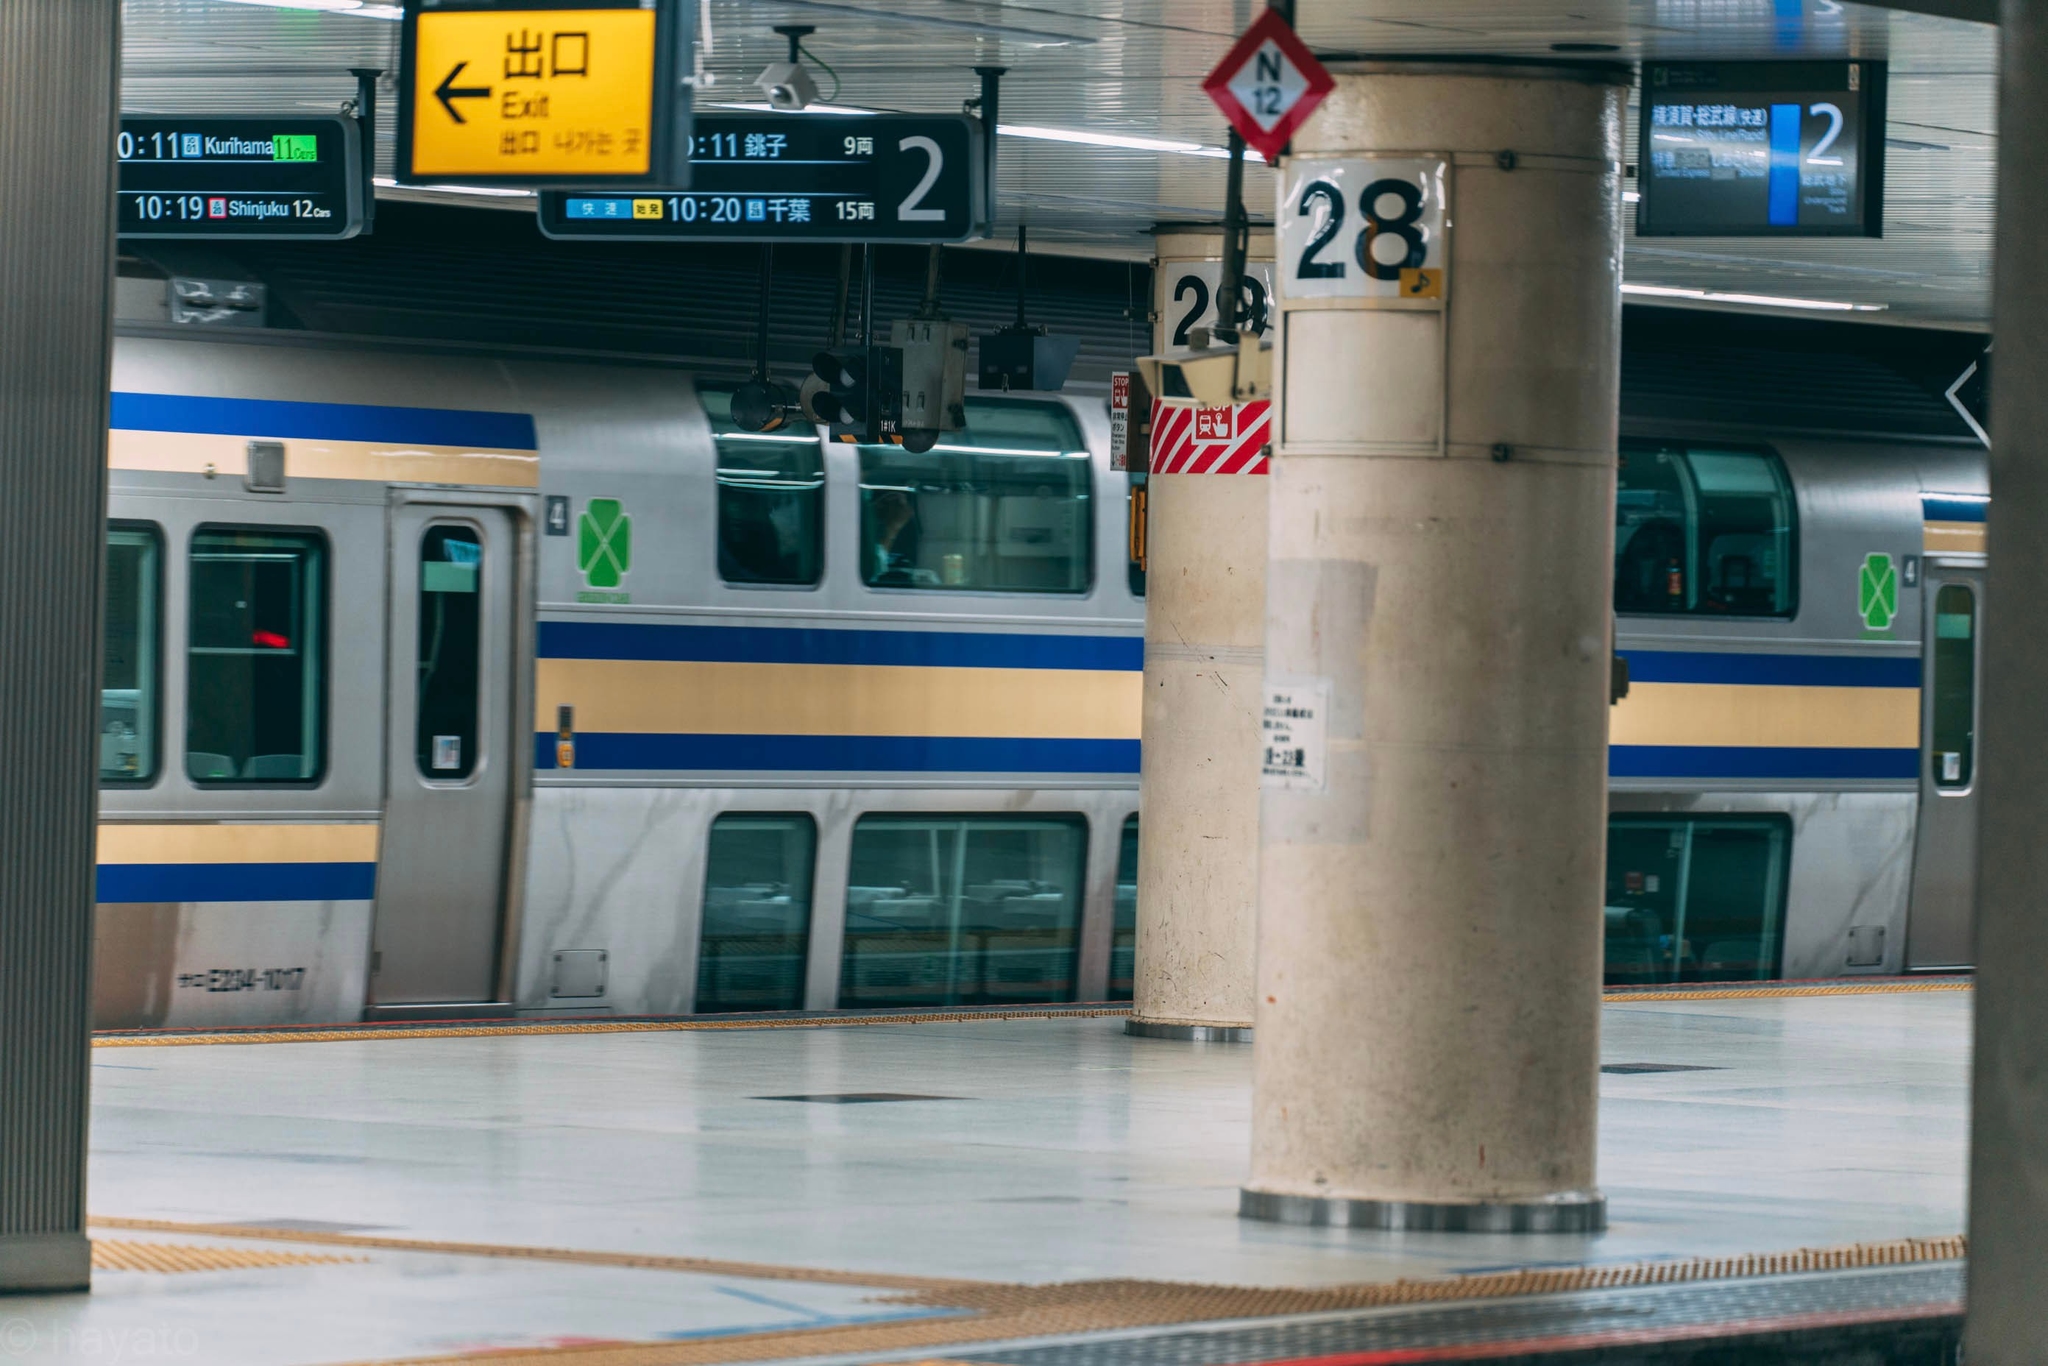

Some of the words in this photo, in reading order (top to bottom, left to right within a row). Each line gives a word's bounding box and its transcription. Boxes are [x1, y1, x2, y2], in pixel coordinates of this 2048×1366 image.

[505, 29, 588, 79] 出口
[1257, 51, 1282, 82] N
[502, 91, 548, 118] Exit
[1253, 87, 1282, 115] 12
[1805, 102, 1844, 160] 2
[117, 132, 179, 158] 0:11
[205, 136, 275, 155] Kurihama
[688, 133, 738, 157] :11
[745, 133, 787, 157] 銚子
[843, 136, 874, 155] 9両
[898, 135, 946, 221] 2
[135, 195, 204, 220] 10:19
[228, 200, 289, 219] Shinjuku
[668, 197, 741, 222] 10:20
[767, 198, 812, 222] 千葉
[836, 201, 875, 220] 15両
[1296, 177, 1428, 281] 28
[1114, 377, 1129, 387] STOP
[548, 502, 566, 530] 4
[1905, 560, 1915, 583] 4
